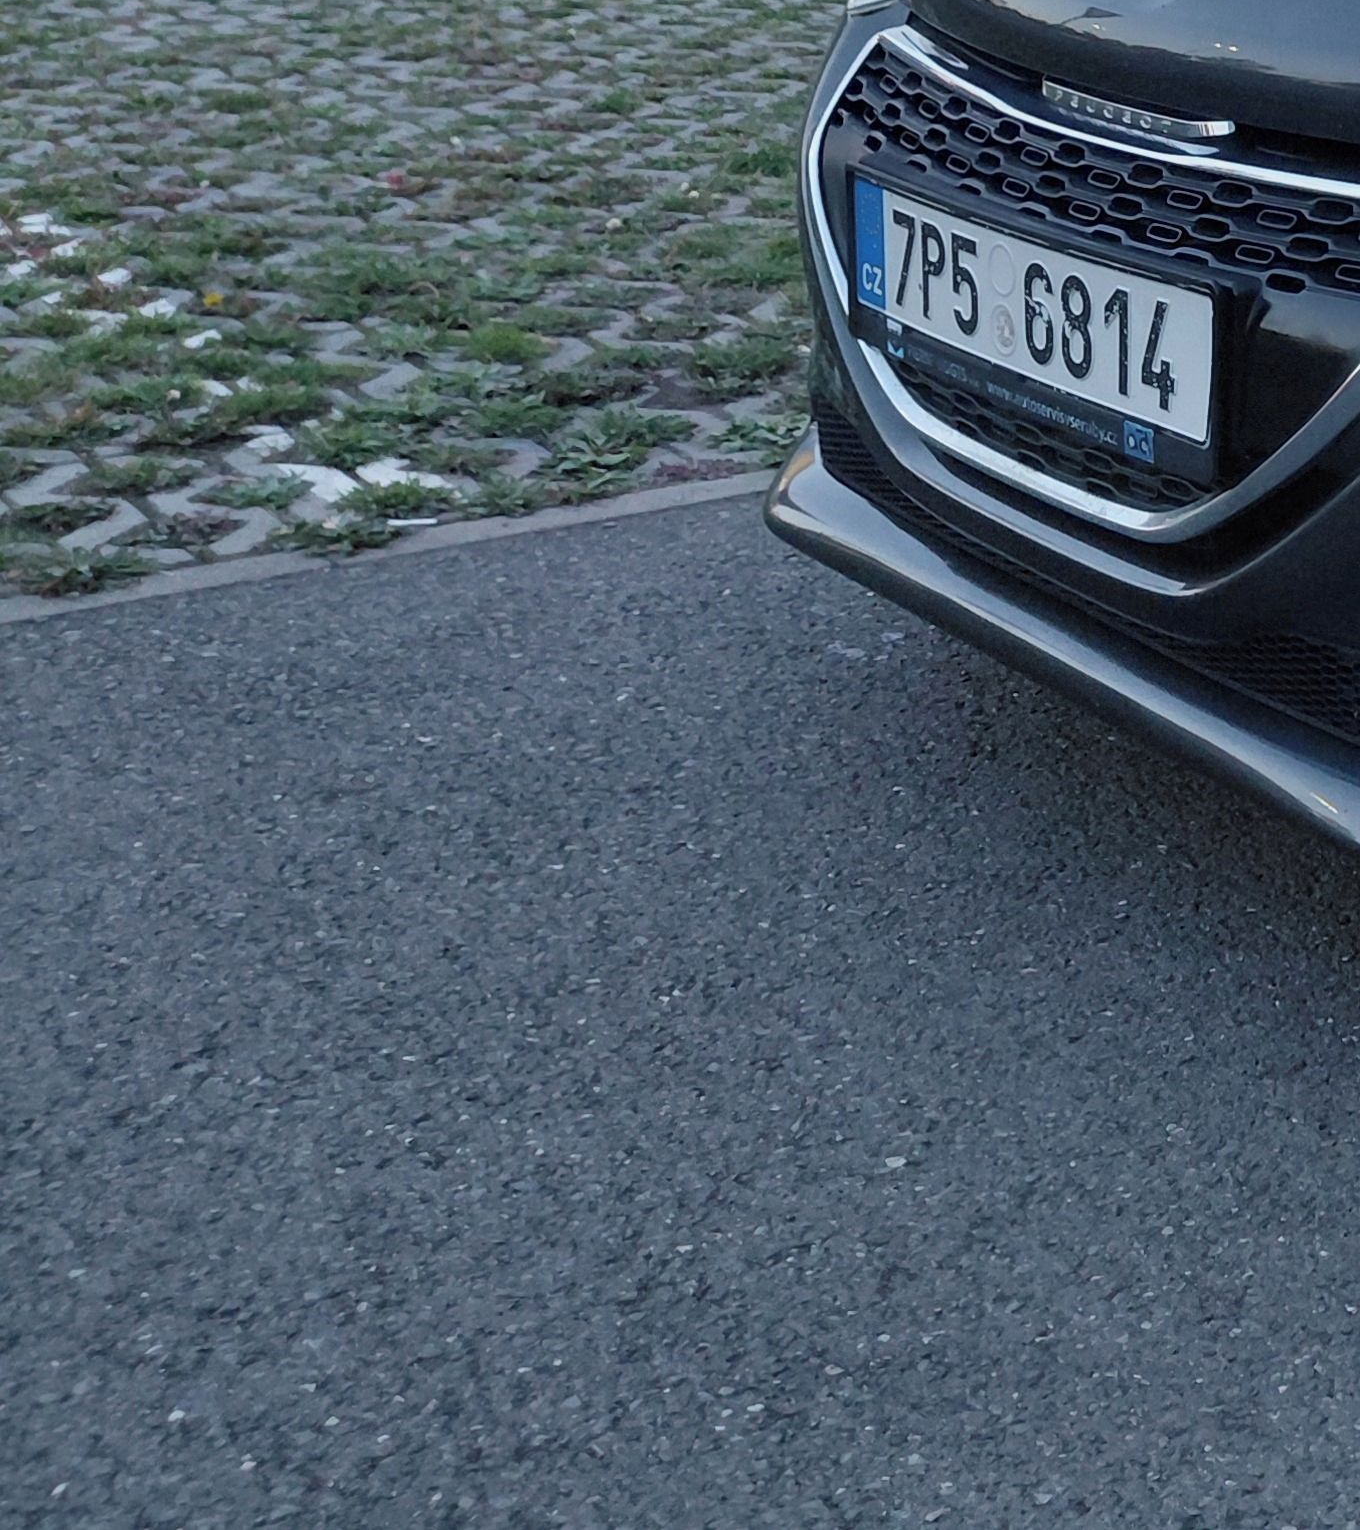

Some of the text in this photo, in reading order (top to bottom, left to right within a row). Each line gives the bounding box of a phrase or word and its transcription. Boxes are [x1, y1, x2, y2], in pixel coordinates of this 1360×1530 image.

[861, 261, 884, 297] CZ
[891, 209, 1177, 412] 7P5 6814
